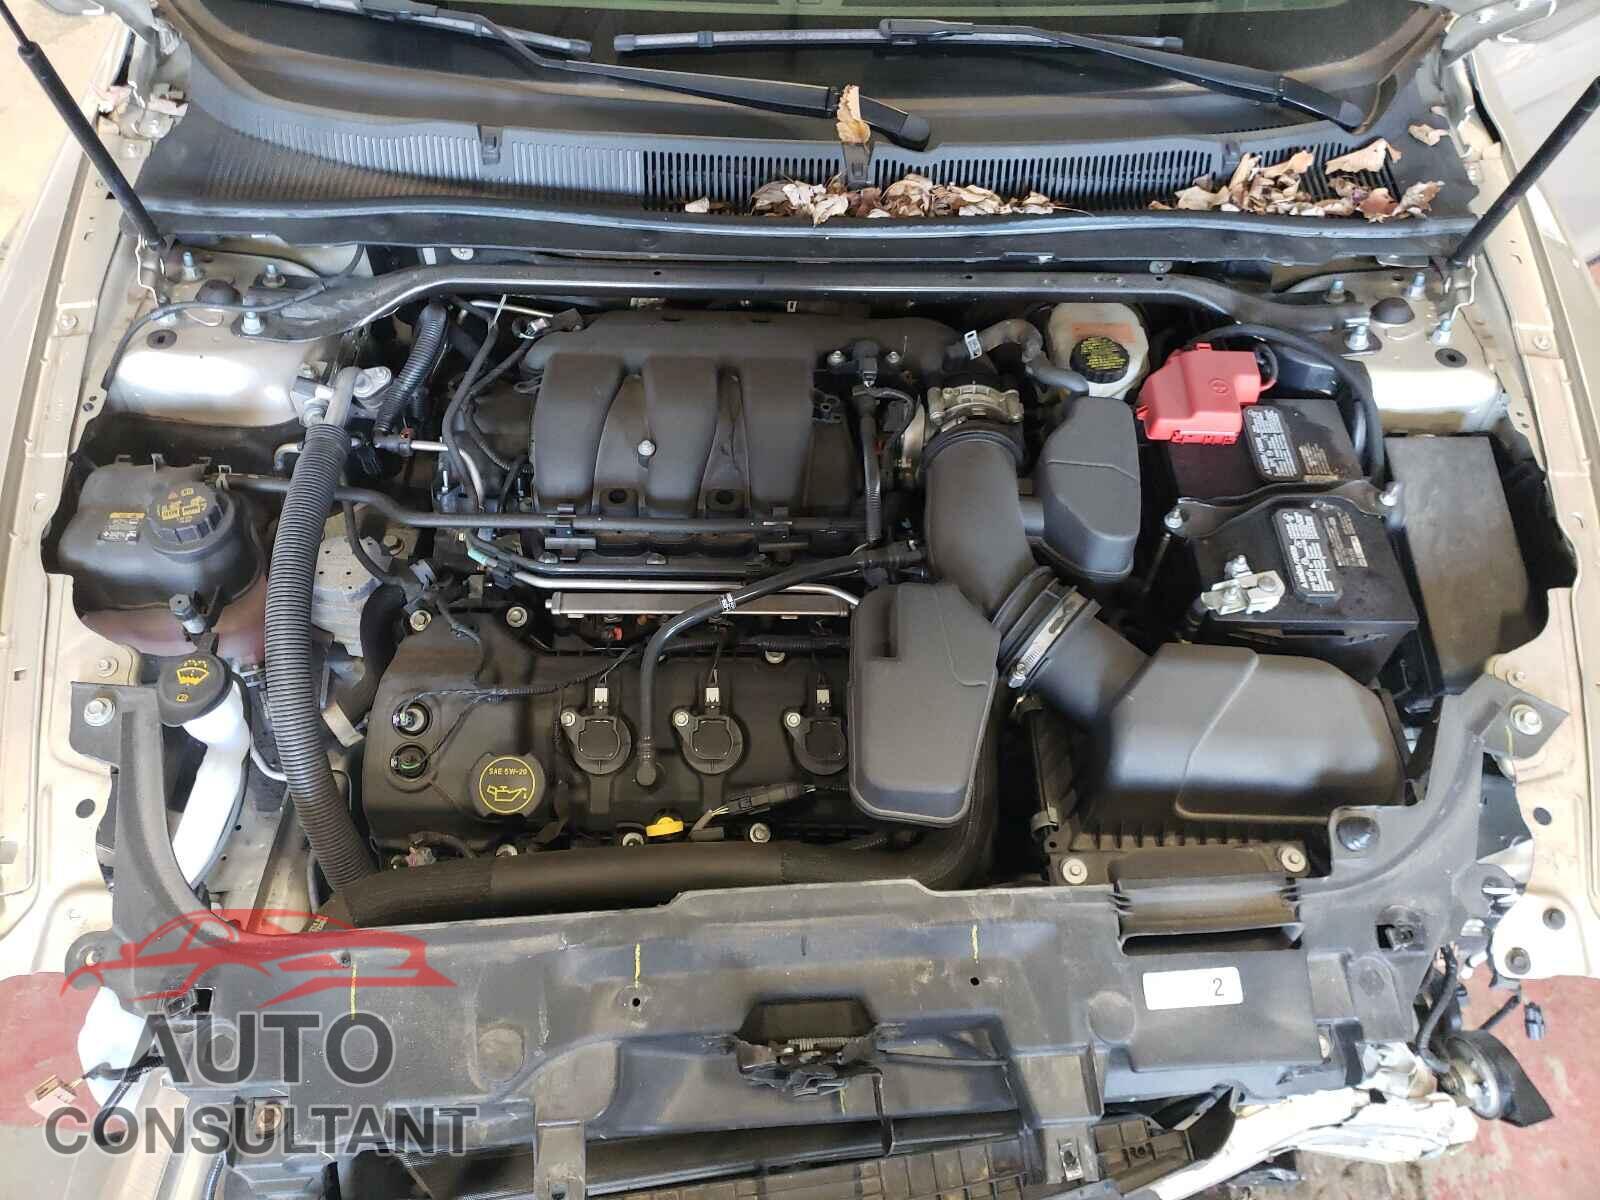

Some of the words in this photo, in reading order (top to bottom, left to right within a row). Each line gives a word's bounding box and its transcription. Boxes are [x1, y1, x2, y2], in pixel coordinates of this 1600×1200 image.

[488, 767, 502, 776] SAE
[504, 767, 528, 776] 5W-20
[1212, 977, 1225, 997] 2
